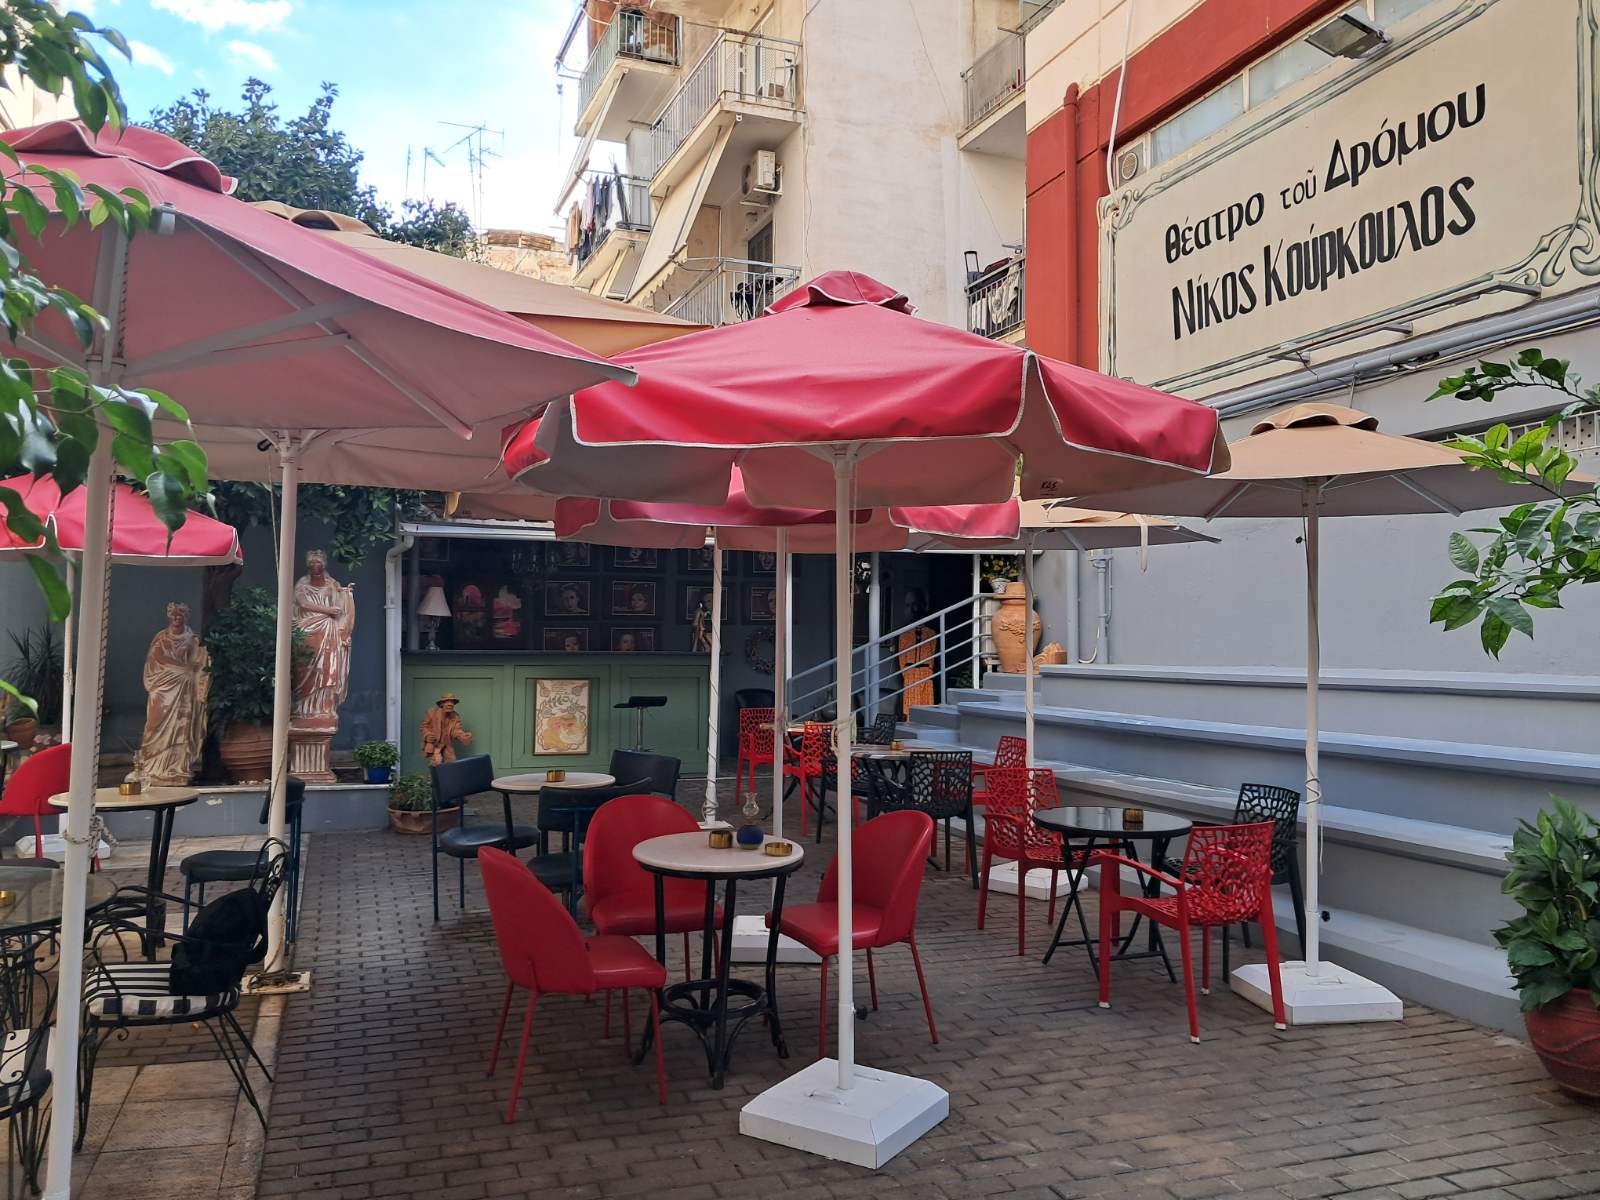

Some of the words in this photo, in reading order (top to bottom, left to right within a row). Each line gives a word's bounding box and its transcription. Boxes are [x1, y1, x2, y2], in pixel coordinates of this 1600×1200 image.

[1323, 82, 1486, 193] Δρόμου
[1171, 263, 1257, 341] Νίκος
[1263, 175, 1477, 307] Κούρκουλος
